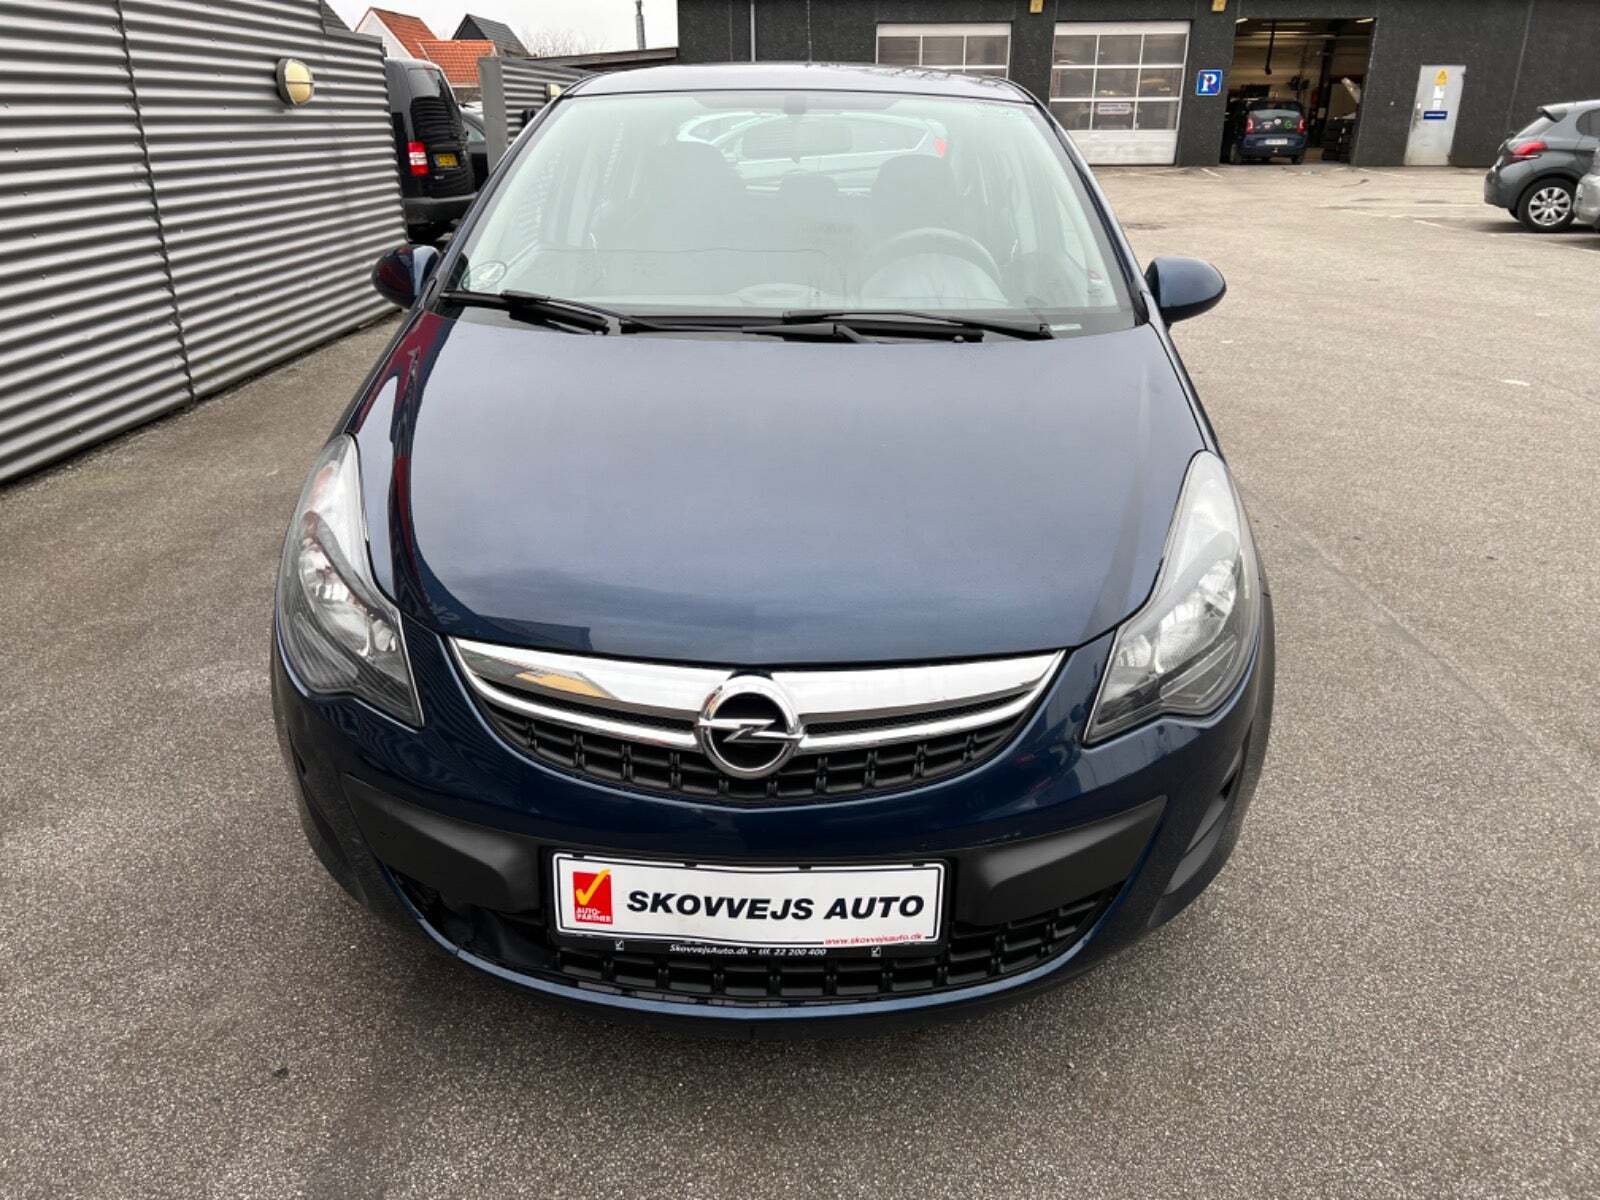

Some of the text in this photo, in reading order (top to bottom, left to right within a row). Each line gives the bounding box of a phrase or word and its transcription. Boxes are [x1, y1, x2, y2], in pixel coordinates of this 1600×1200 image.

[1201, 74, 1217, 92] P
[627, 890, 924, 920] SKOVVEJS AUTO
[576, 907, 602, 916] AUTO-
[576, 913, 611, 923] PARTNER
[825, 933, 922, 945] www.skovvejsauto.dk
[669, 943, 748, 955] SkovvejsAuto.dk
[774, 948, 785, 956] 22
[788, 948, 807, 956] 200
[808, 948, 827, 956] 400
